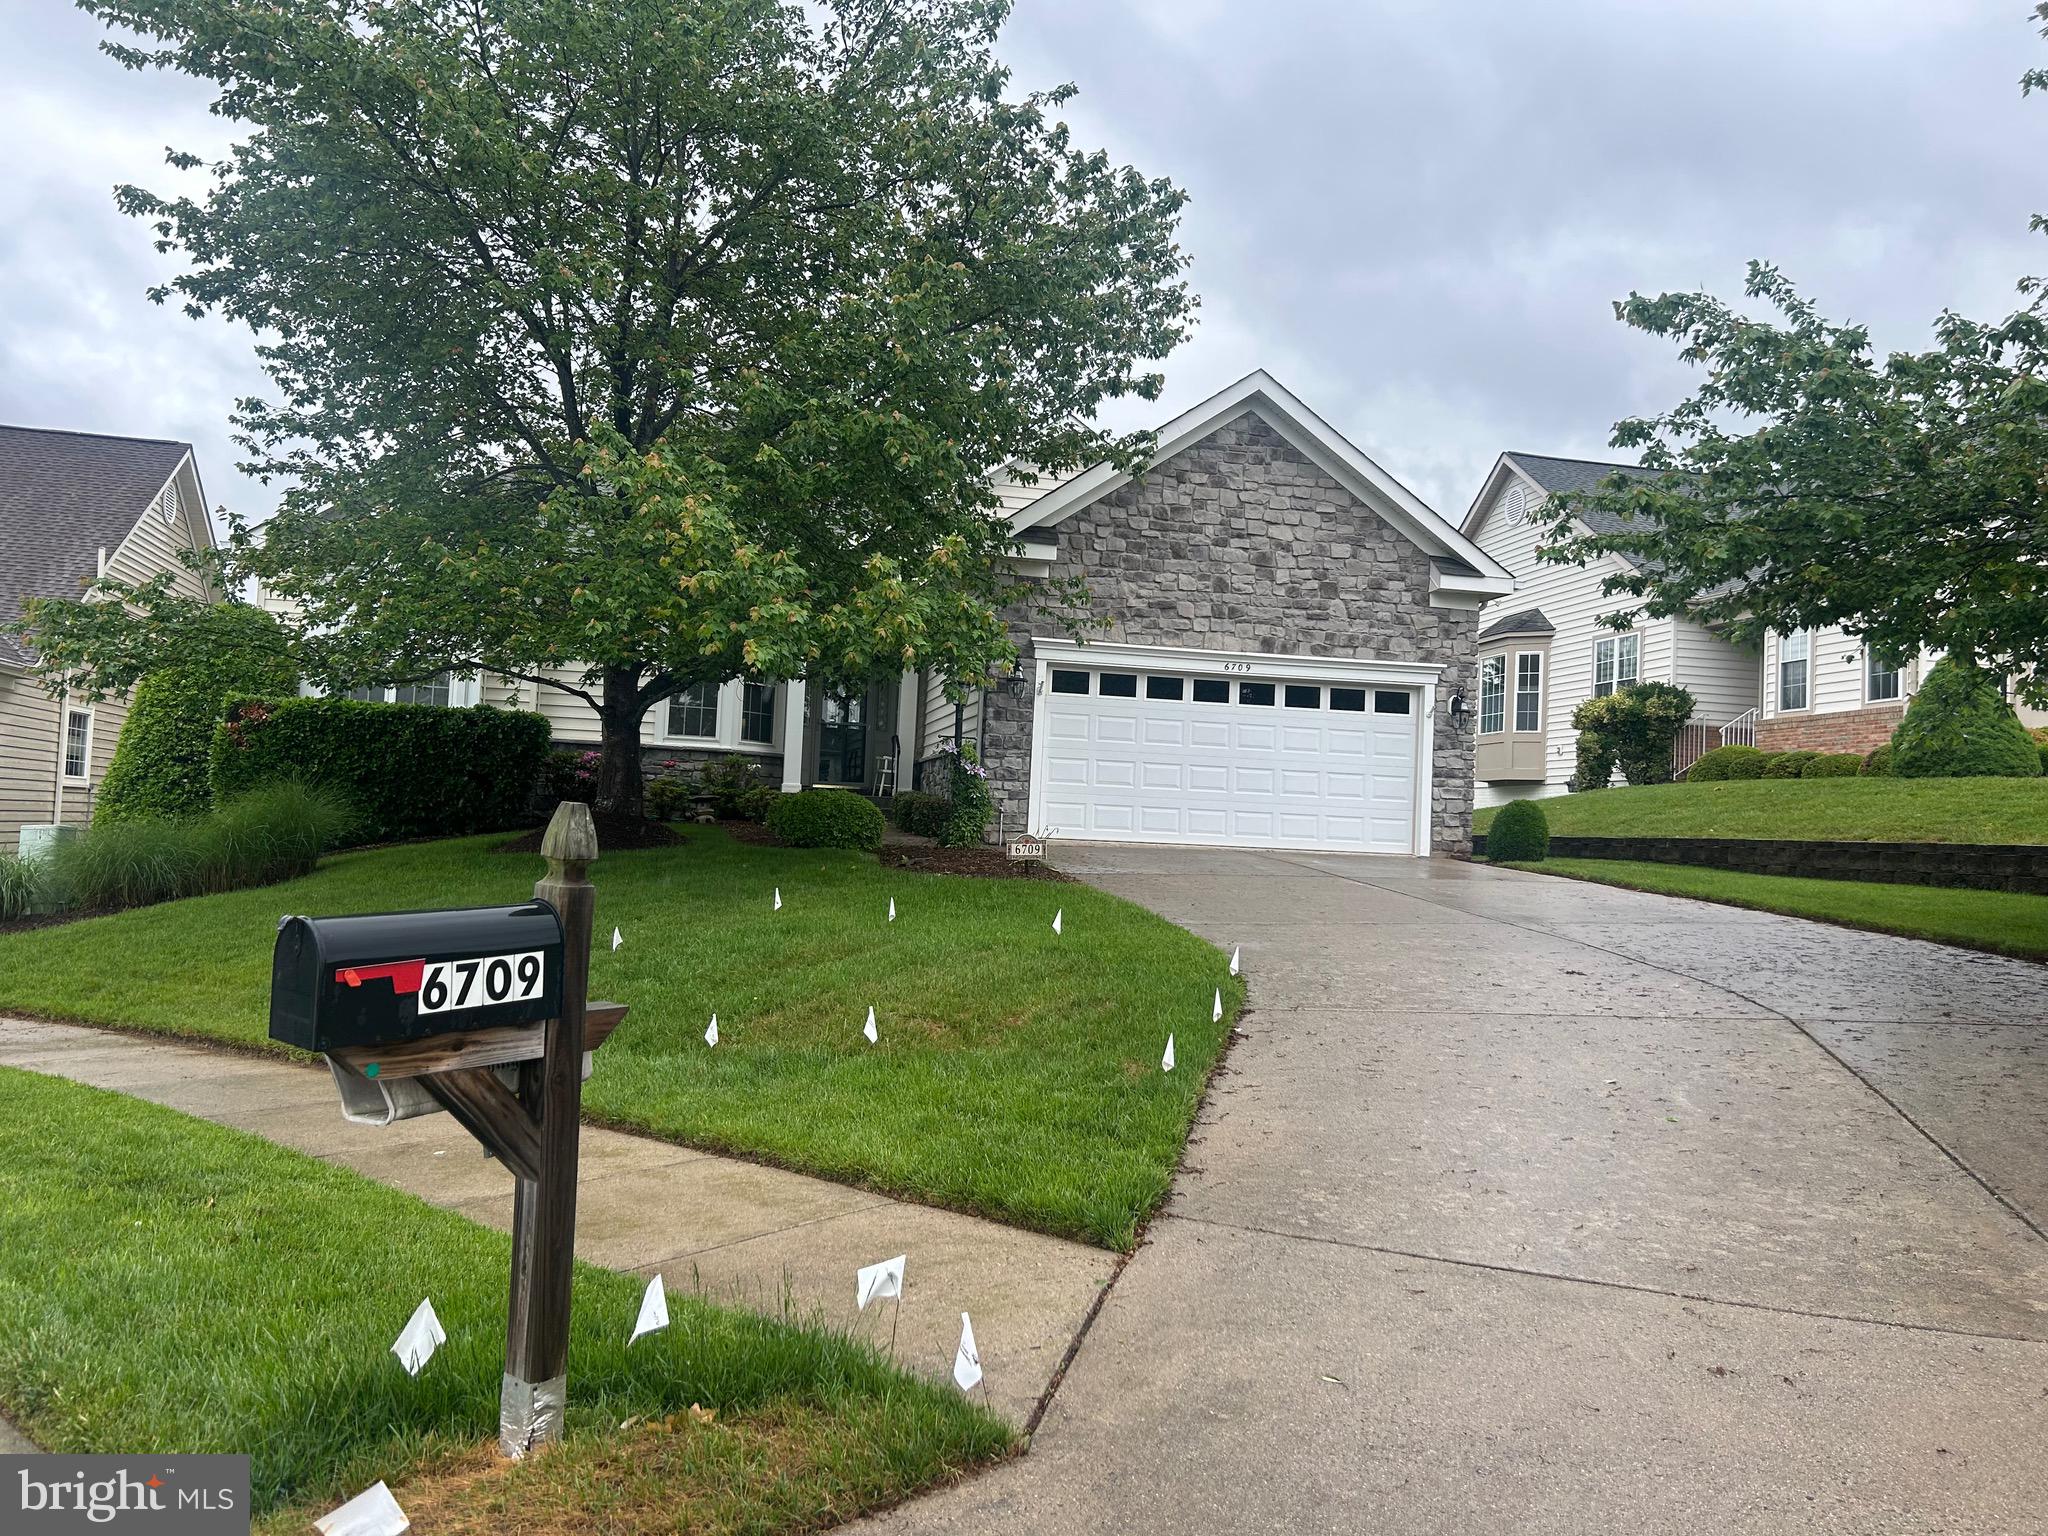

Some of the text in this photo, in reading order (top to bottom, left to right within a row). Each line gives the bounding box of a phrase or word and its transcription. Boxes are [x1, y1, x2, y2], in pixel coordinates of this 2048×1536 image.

[1224, 662, 1251, 672] 6709
[1015, 844, 1041, 855] 6709
[422, 955, 540, 1010] 6709
